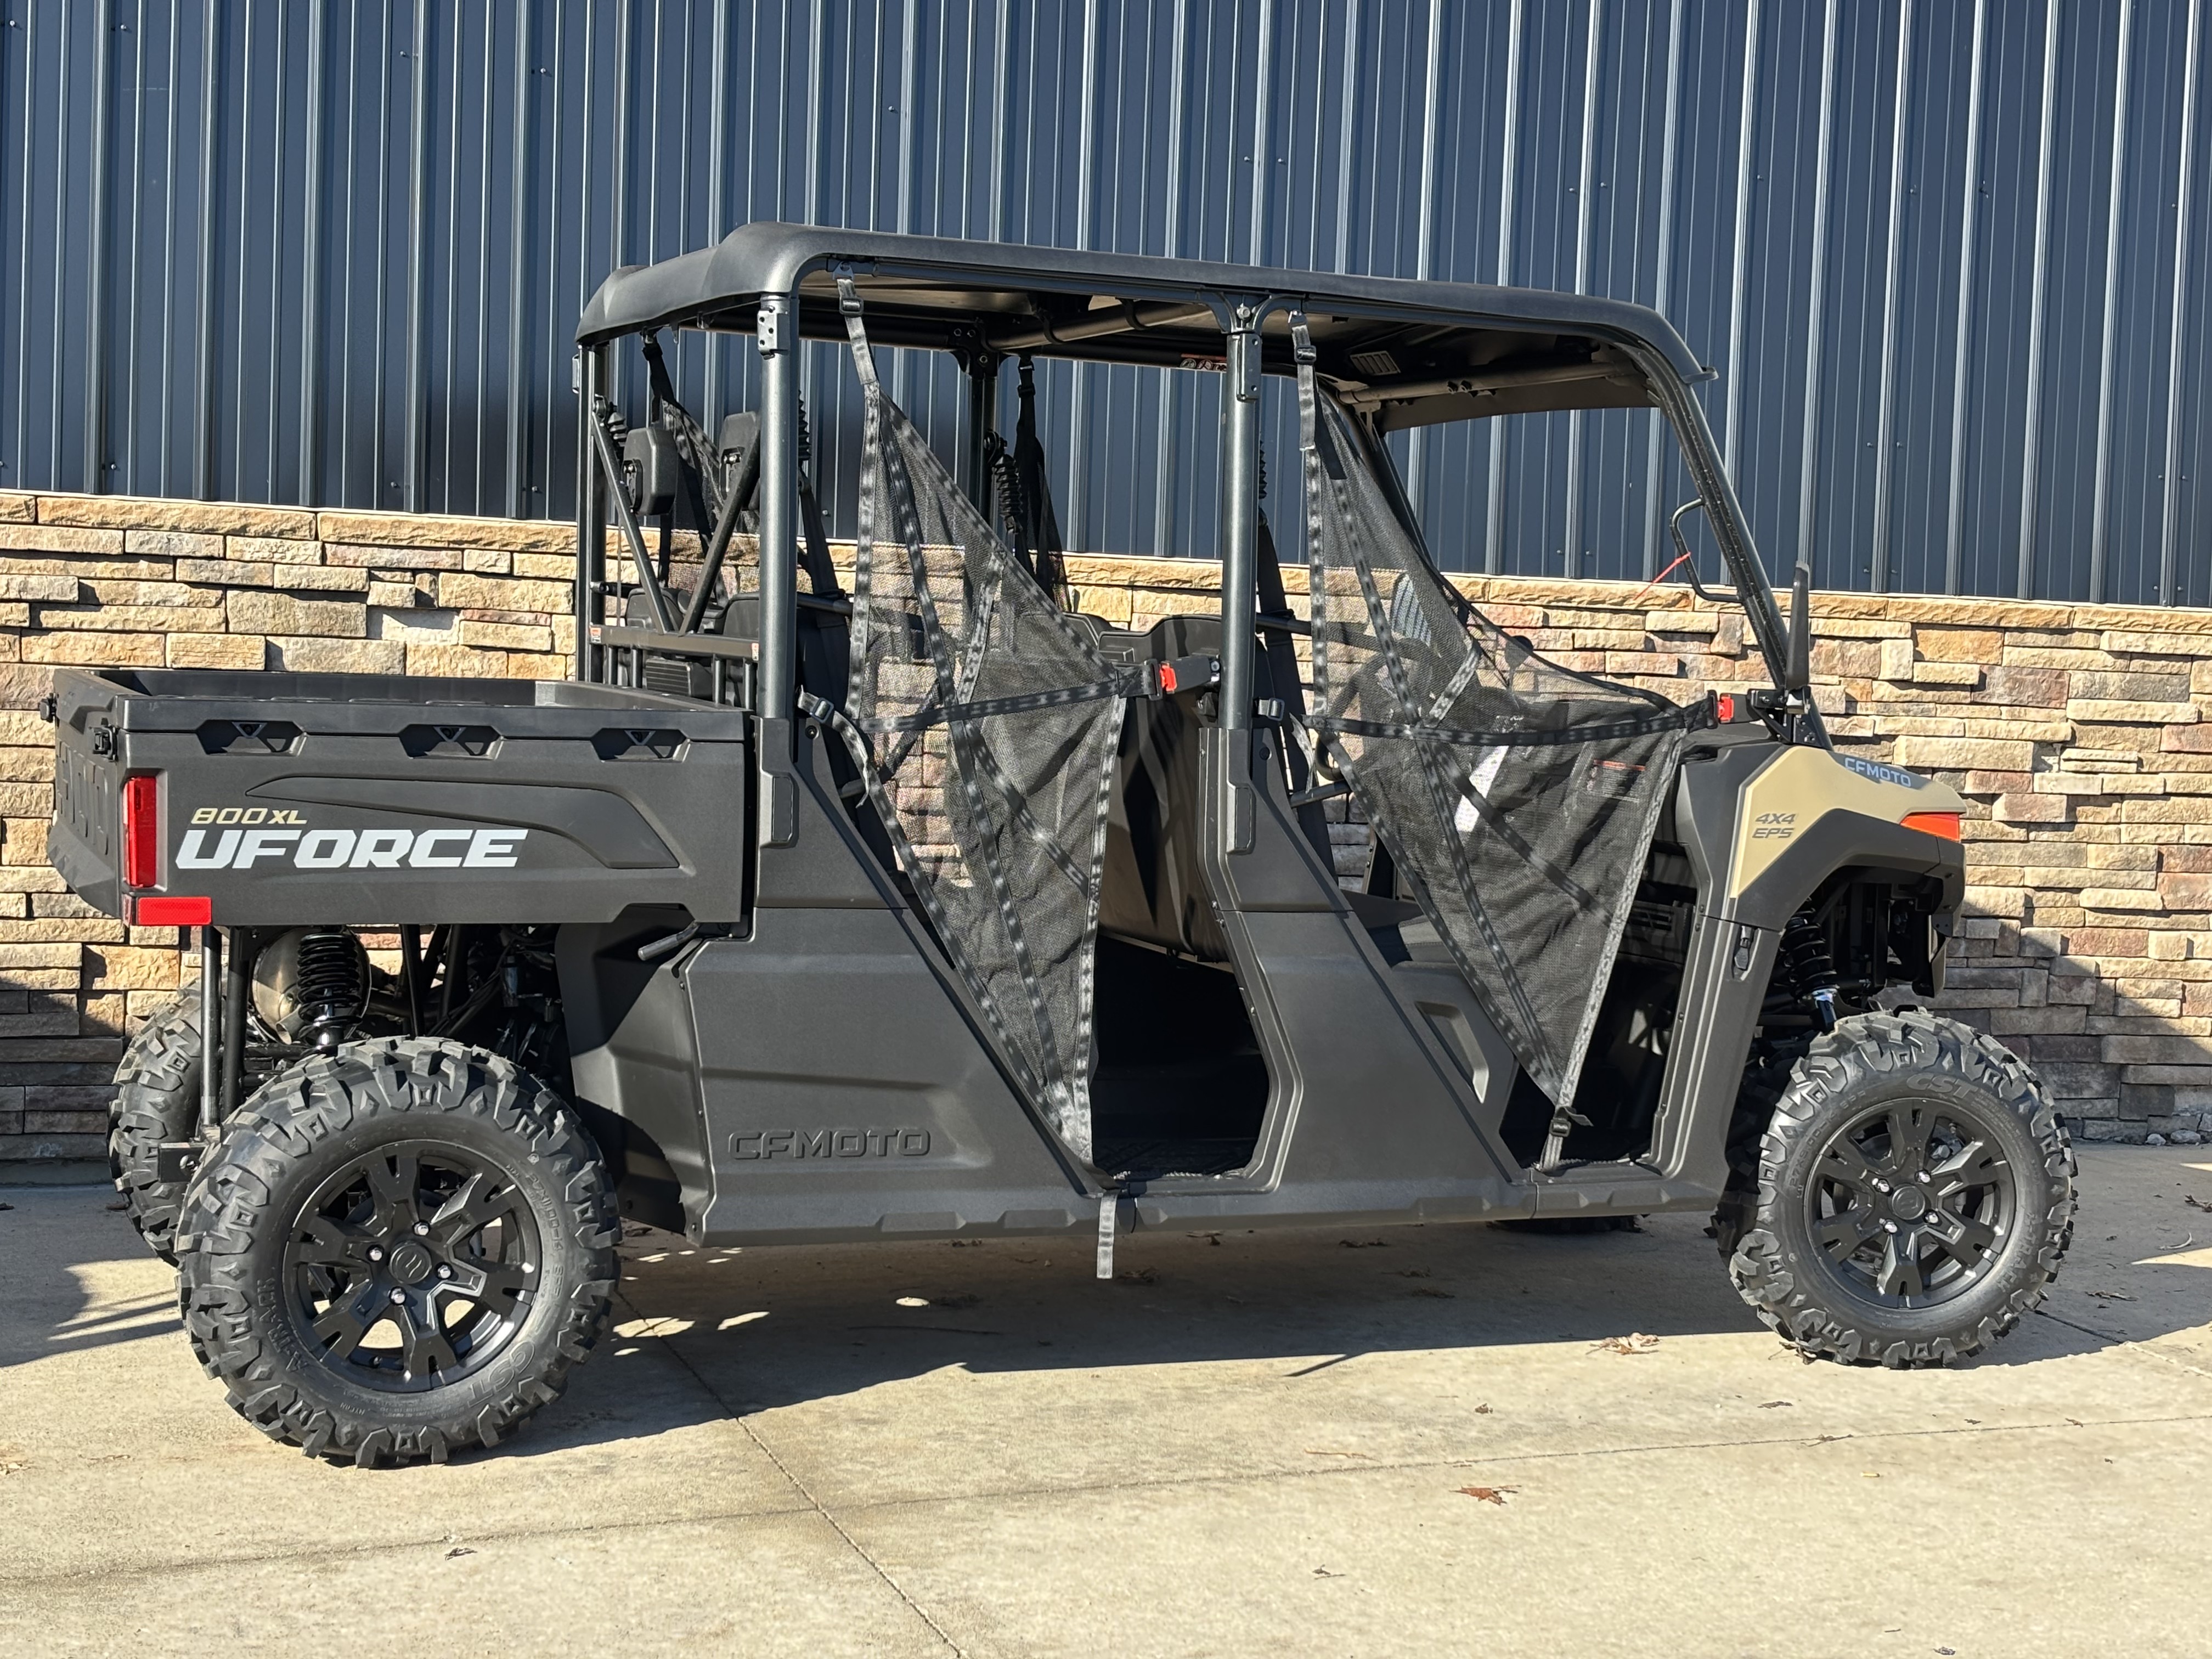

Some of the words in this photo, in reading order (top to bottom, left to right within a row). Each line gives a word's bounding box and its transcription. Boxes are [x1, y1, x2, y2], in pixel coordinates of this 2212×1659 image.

[1844, 757, 1911, 788] CFMOTO
[1752, 827, 1794, 839] EPS
[1755, 814, 1800, 825] 4X4
[175, 830, 529, 869] UFORCE
[1906, 1072, 1979, 1098] CST
[728, 1128, 931, 1160] CFMOTO
[467, 1340, 535, 1408] CST
